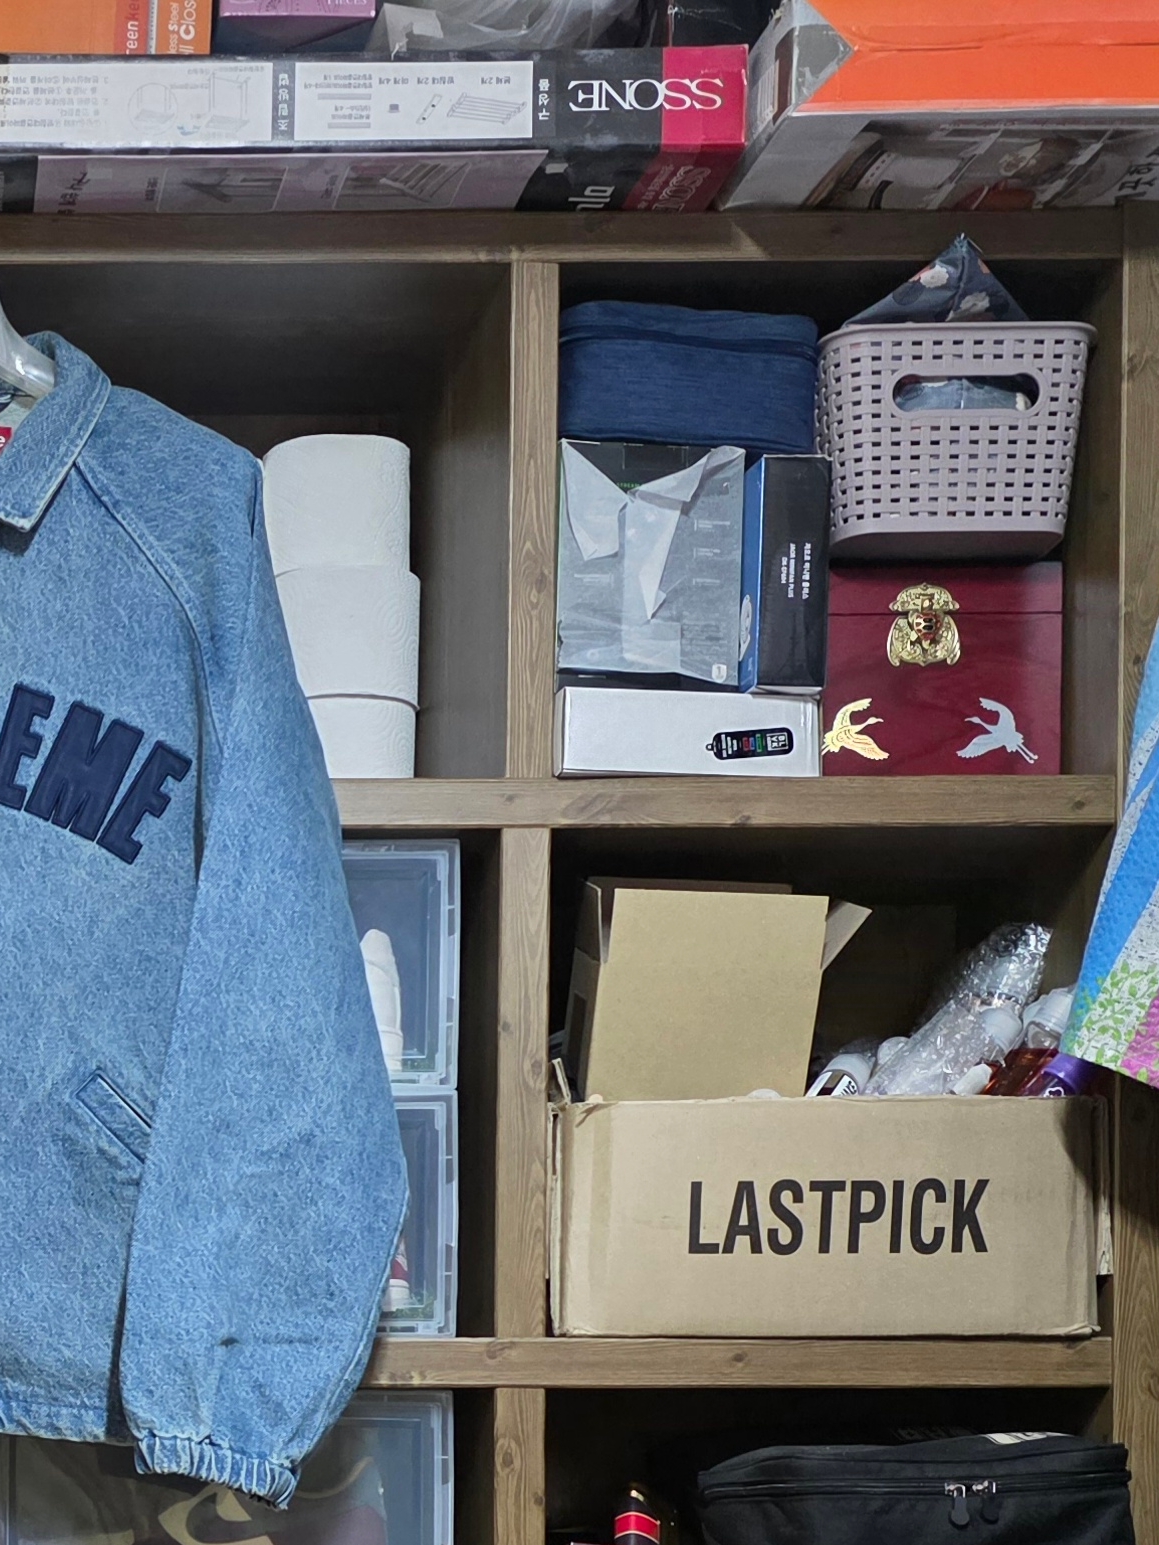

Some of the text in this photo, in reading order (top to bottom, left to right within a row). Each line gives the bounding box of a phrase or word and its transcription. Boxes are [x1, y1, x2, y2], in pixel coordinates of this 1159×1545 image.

[378, 75, 392, 86] 4개
[417, 75, 455, 86] 받침대 2개
[480, 75, 512, 86] 본체 2개
[568, 77, 724, 112] SSONE
[277, 72, 290, 131] 조립방법
[538, 78, 551, 121] 구성품
[688, 1178, 990, 1256] LASTPICK
